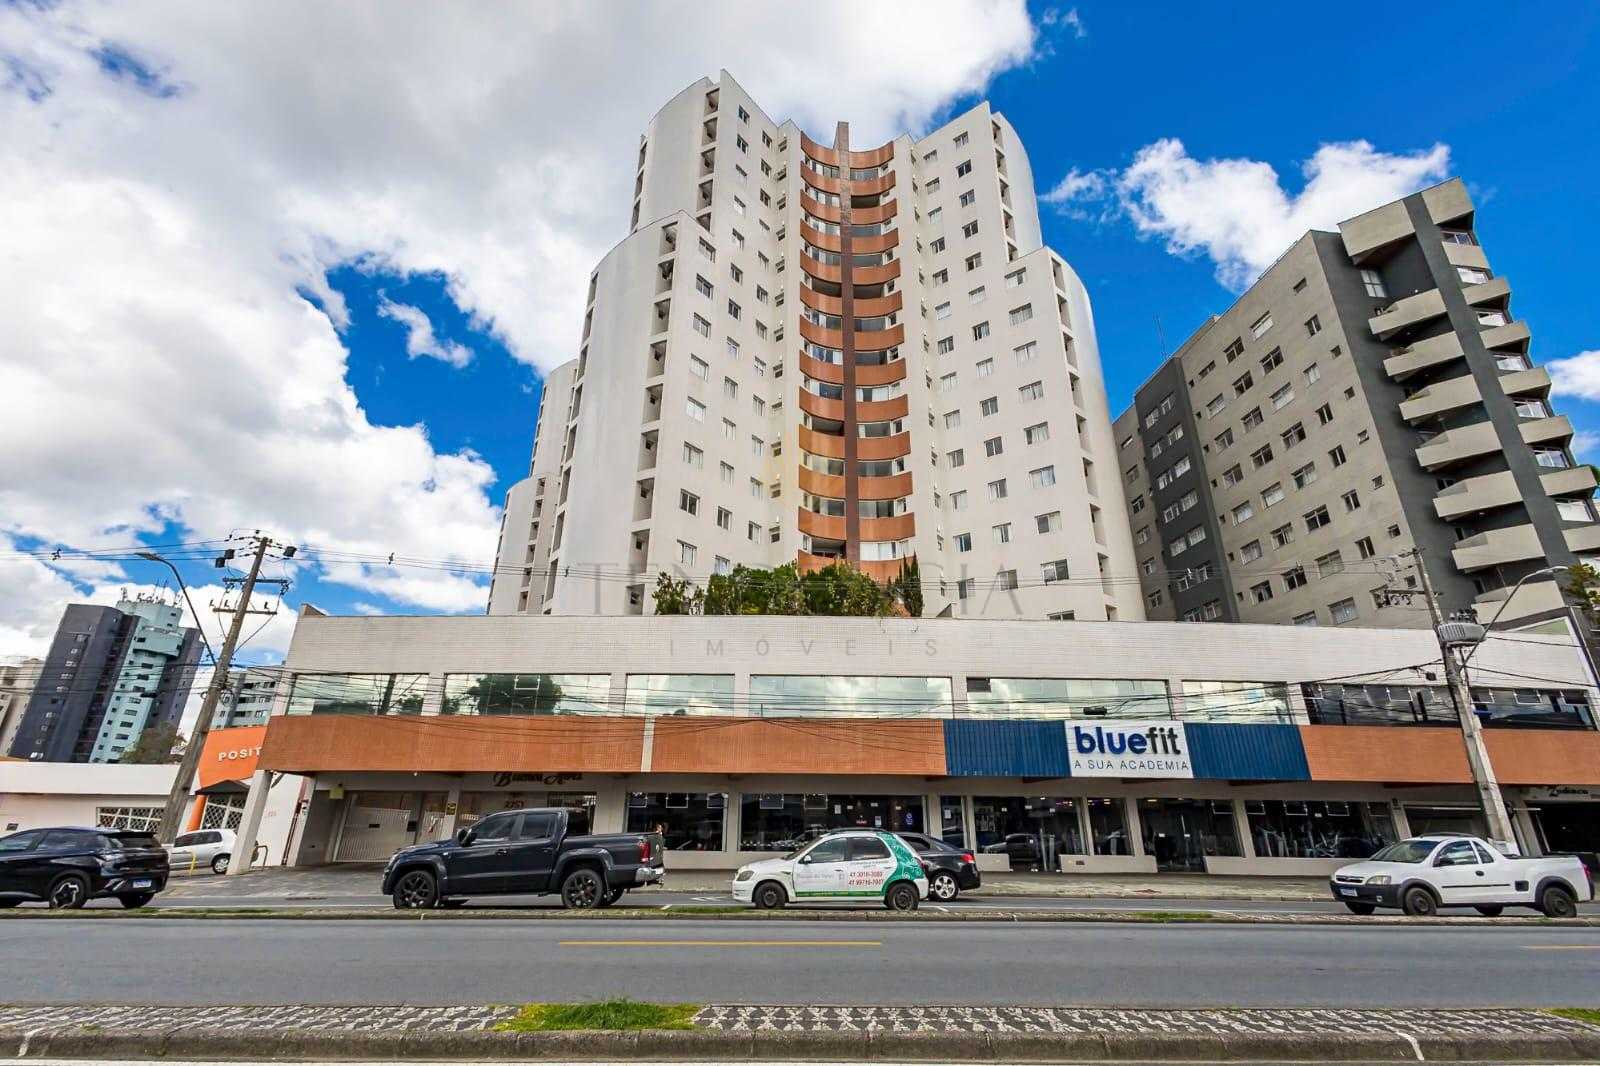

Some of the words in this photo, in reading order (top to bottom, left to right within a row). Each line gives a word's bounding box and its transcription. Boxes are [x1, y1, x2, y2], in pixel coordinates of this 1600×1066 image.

[1074, 726, 1181, 754] bluefit
[1074, 760, 1081, 768] A
[1088, 760, 1114, 769] SUA
[1120, 760, 1189, 770] ACADEMIA
